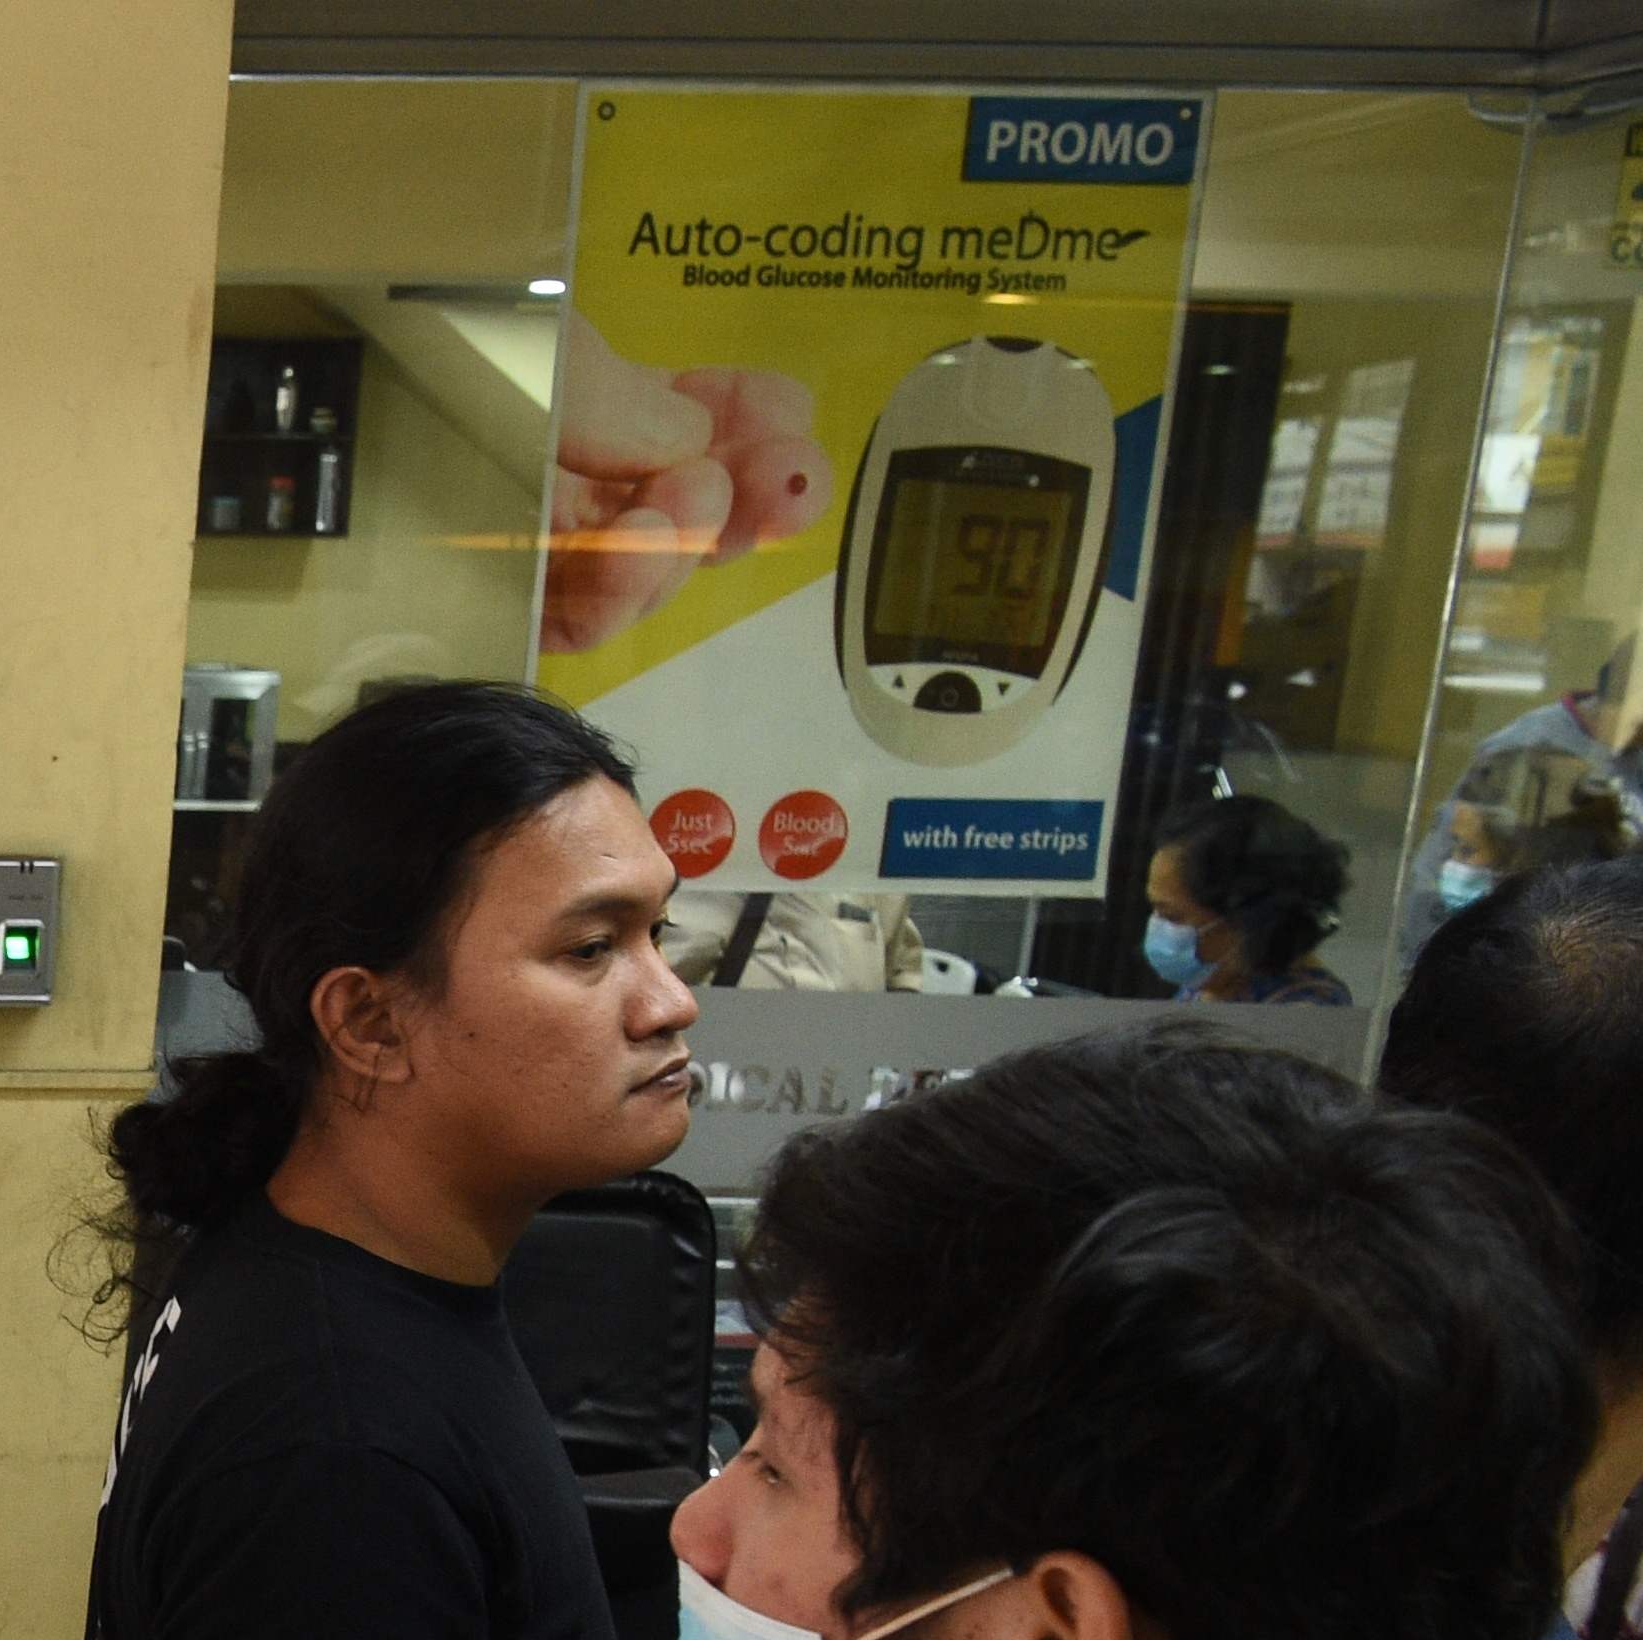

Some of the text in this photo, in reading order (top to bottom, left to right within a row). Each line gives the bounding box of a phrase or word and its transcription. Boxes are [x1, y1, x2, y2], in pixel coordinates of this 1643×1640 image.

[985, 120, 1175, 167] PROMO
[628, 210, 925, 269] Auto-coding
[682, 264, 1067, 296] Blood Glucose Monitoring System
[953, 512, 1051, 600] 90
[671, 810, 714, 831] Just
[772, 811, 838, 834] Blood
[903, 826, 1089, 854] with free strips
